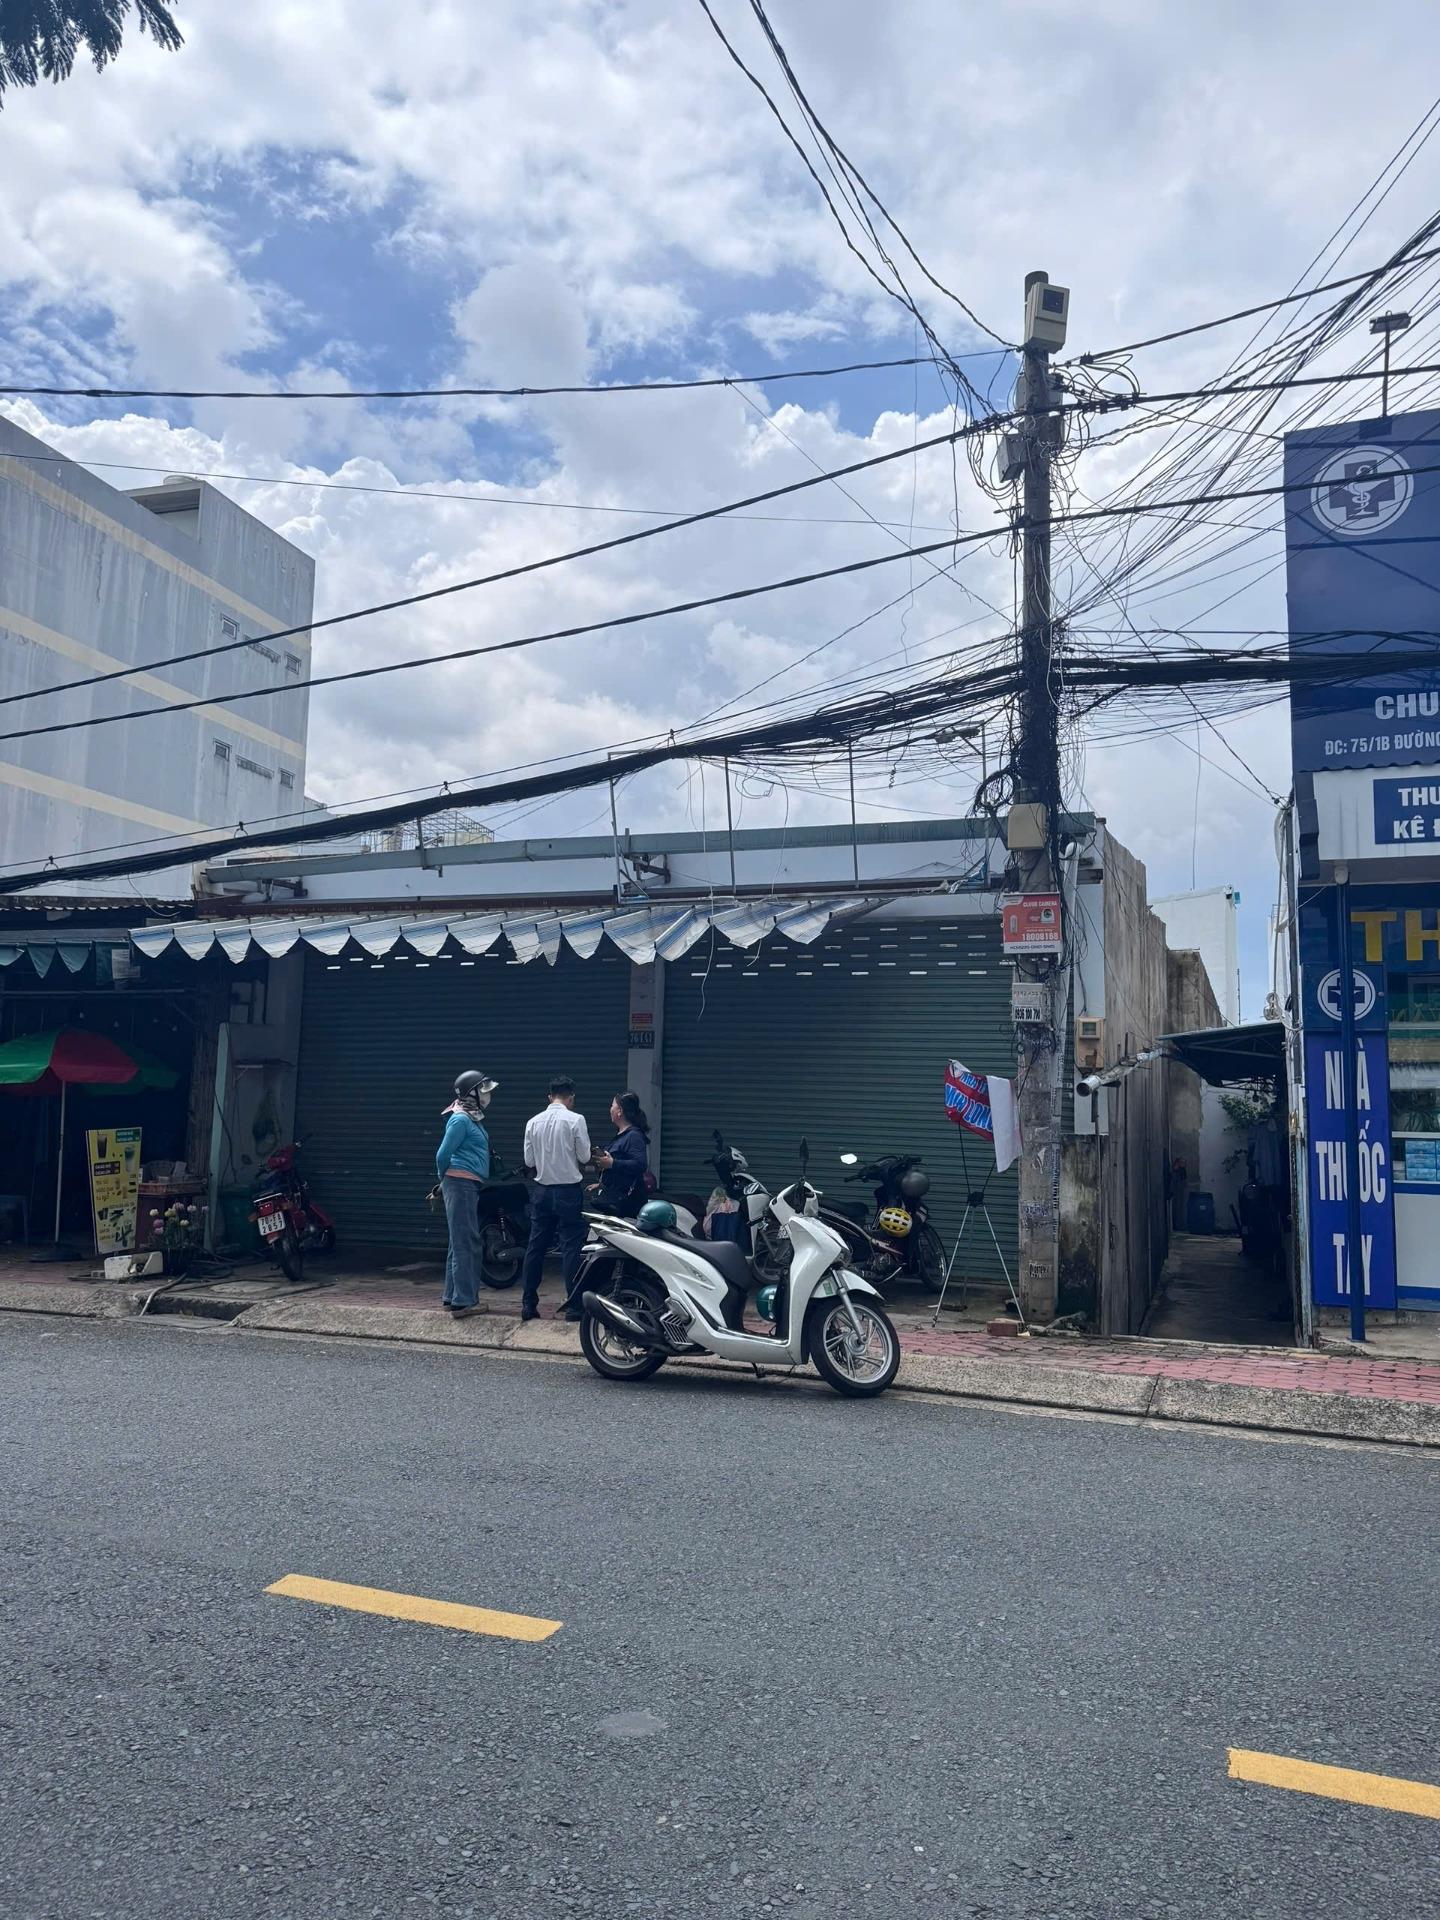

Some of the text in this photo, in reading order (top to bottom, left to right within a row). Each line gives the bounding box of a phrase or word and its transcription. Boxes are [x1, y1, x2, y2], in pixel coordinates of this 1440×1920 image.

[1325, 740, 1348, 755] ĐC:
[1351, 736, 1390, 752] 75/1B
[1393, 815, 1426, 839] KÊ
